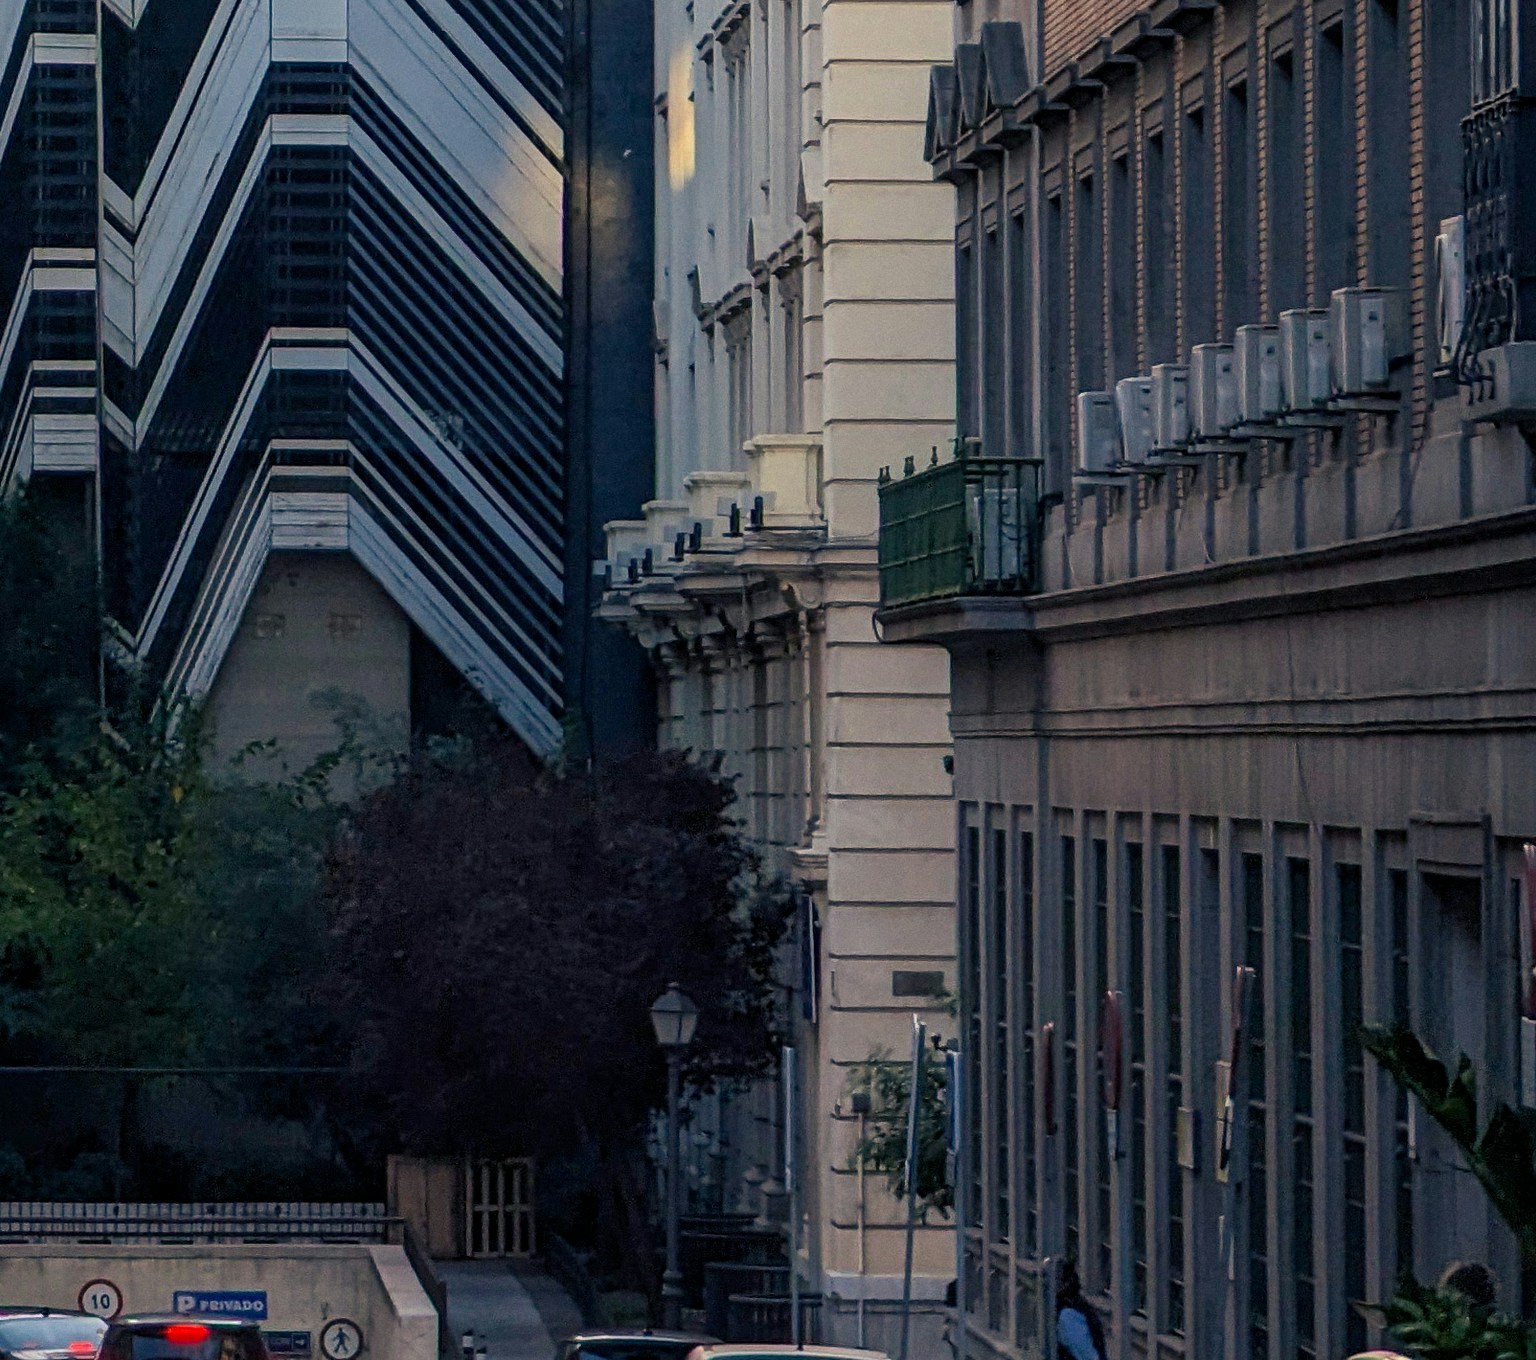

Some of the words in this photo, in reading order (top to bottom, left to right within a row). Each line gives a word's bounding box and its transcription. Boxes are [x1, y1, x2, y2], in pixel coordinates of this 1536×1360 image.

[91, 1293, 111, 1309] 10
[177, 1295, 196, 1313] P
[200, 1300, 264, 1312] PRIVADO
